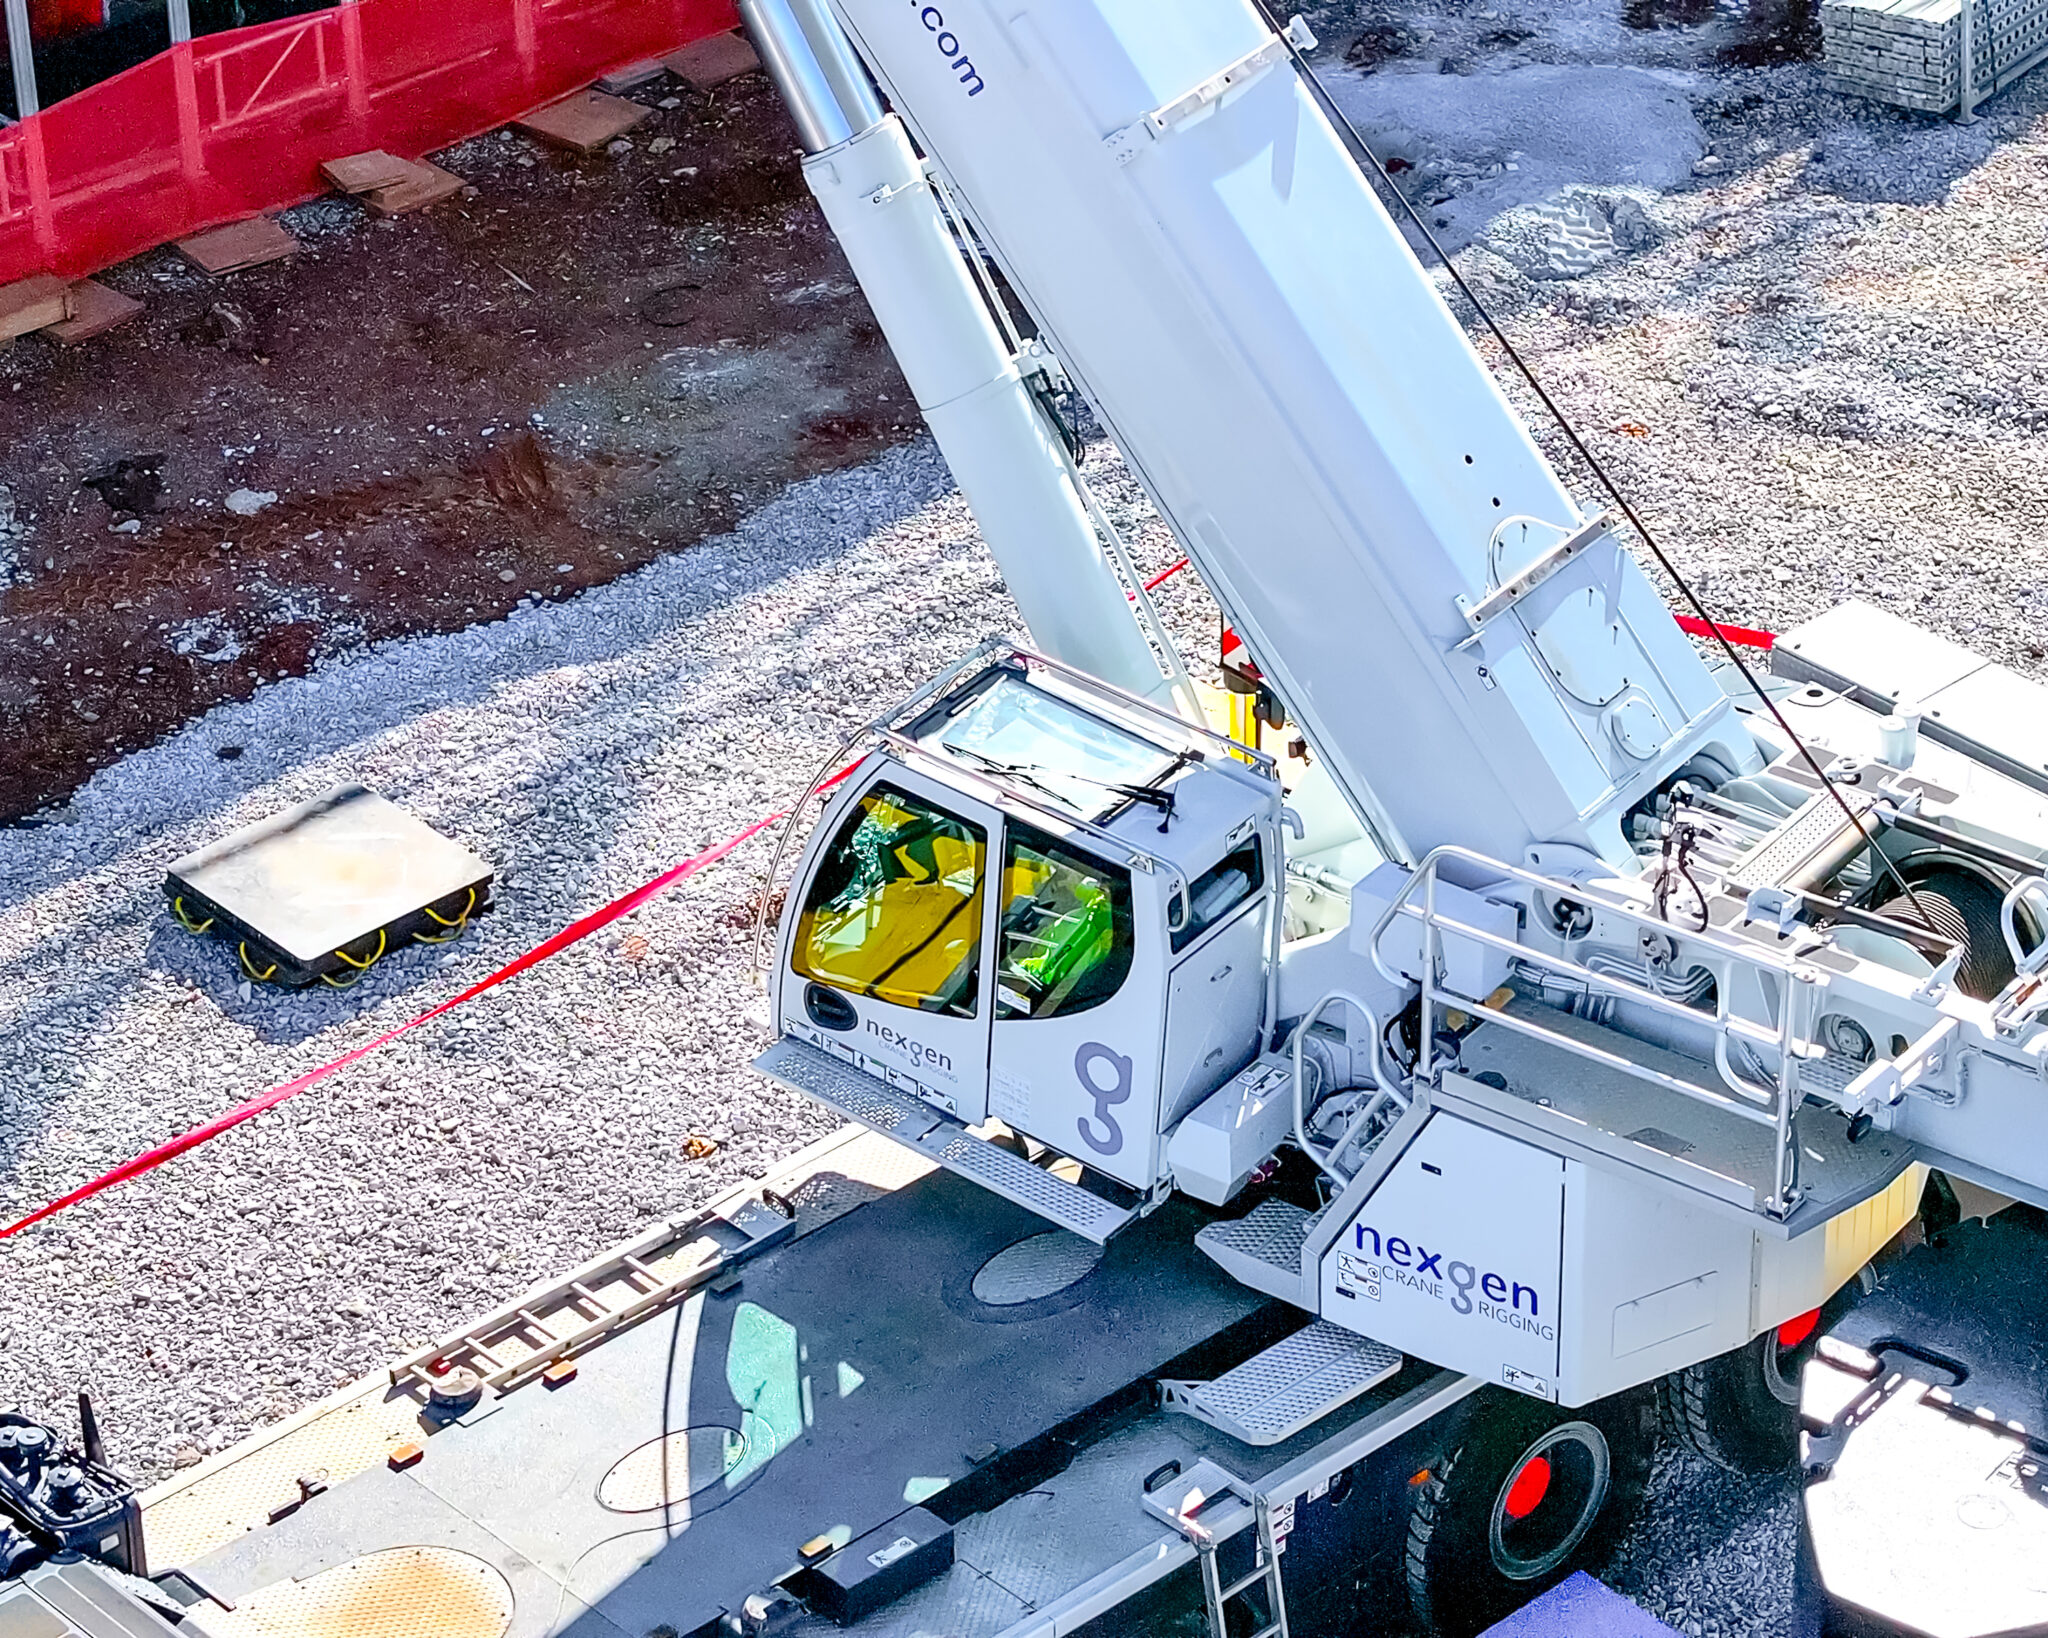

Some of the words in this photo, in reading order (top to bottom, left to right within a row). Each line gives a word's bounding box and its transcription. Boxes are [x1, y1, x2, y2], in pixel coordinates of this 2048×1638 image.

[866, 1018, 951, 1071] nexgen
[1356, 1222, 1538, 1316] nexgen
[1382, 1265, 1444, 1301] CRANE
[1478, 1301, 1554, 1341] RIGGING
